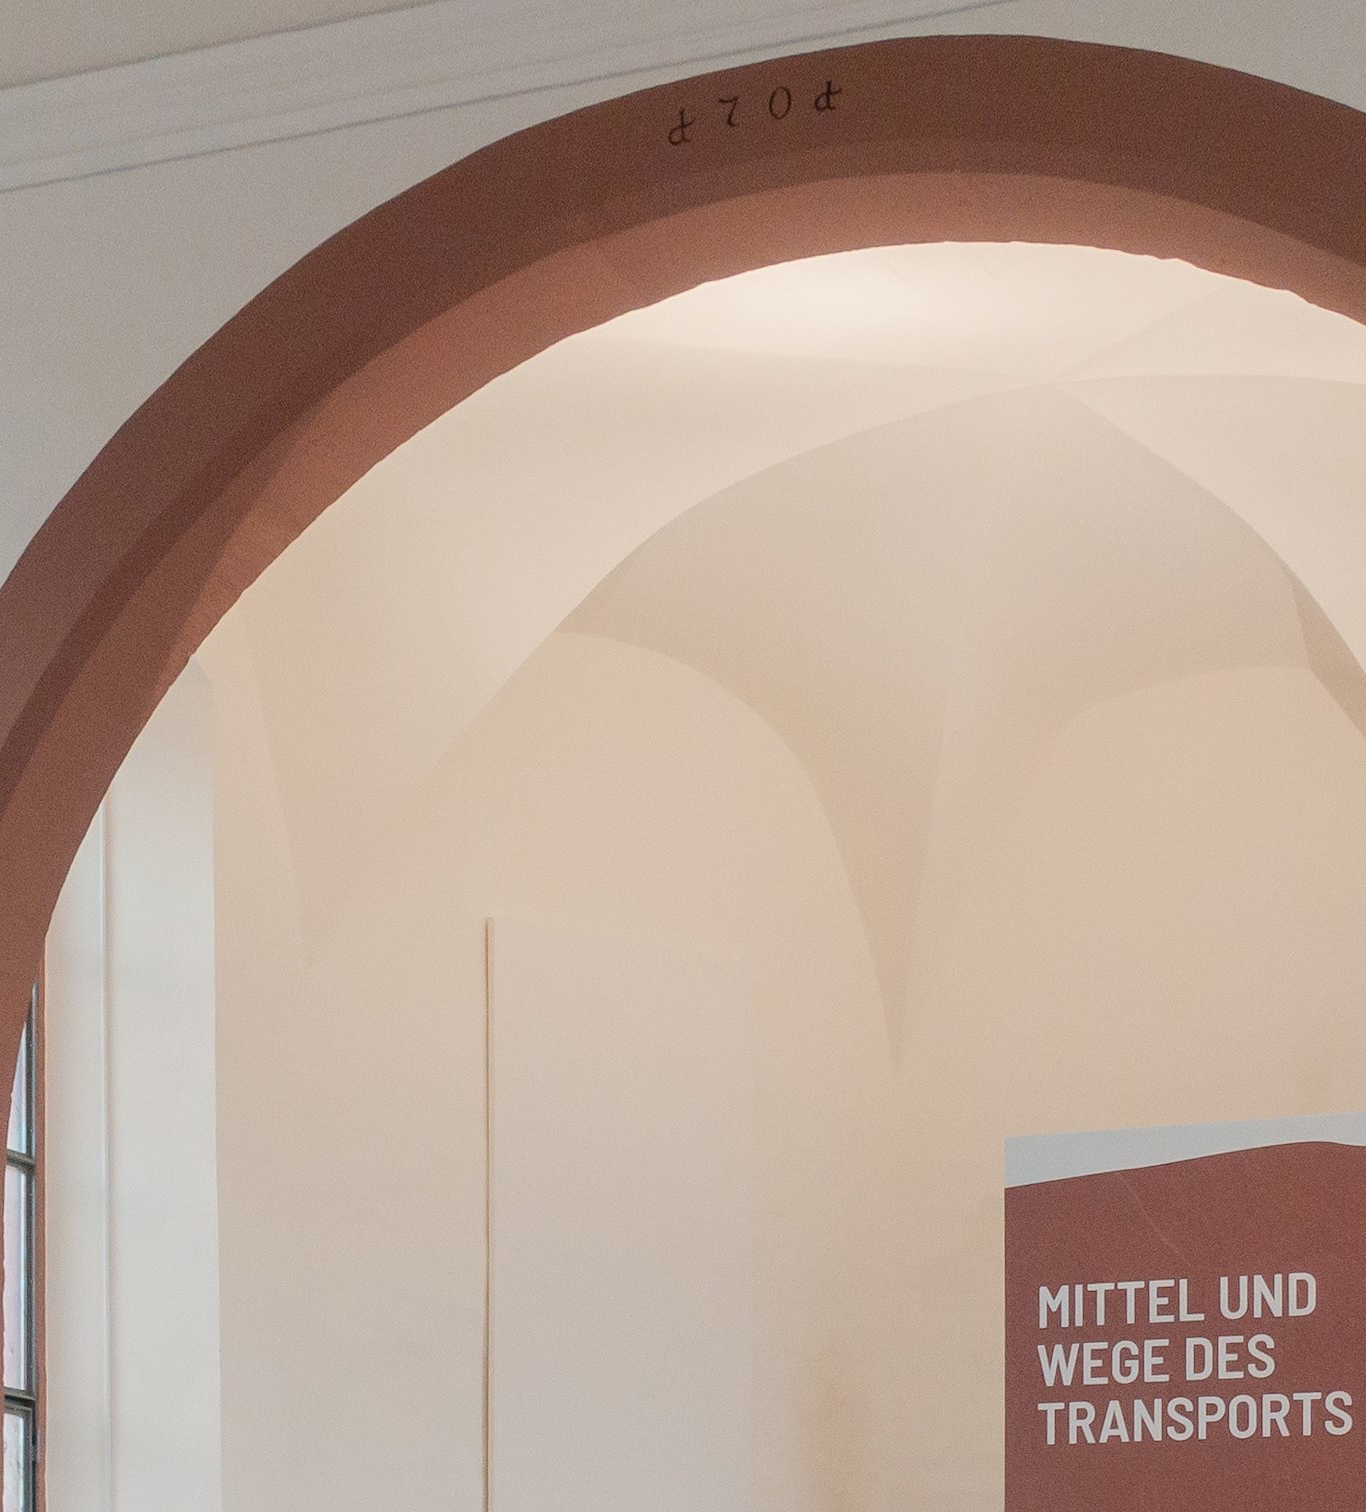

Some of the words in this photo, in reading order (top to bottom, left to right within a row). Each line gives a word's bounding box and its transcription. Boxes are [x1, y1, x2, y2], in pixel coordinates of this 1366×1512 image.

[1039, 1278, 1204, 1328] MITTEL
[1219, 1272, 1316, 1319] UND
[1037, 1338, 1169, 1386] WEGE
[1185, 1333, 1275, 1380] DES
[1037, 1390, 1352, 1444] TRANSPORTS
